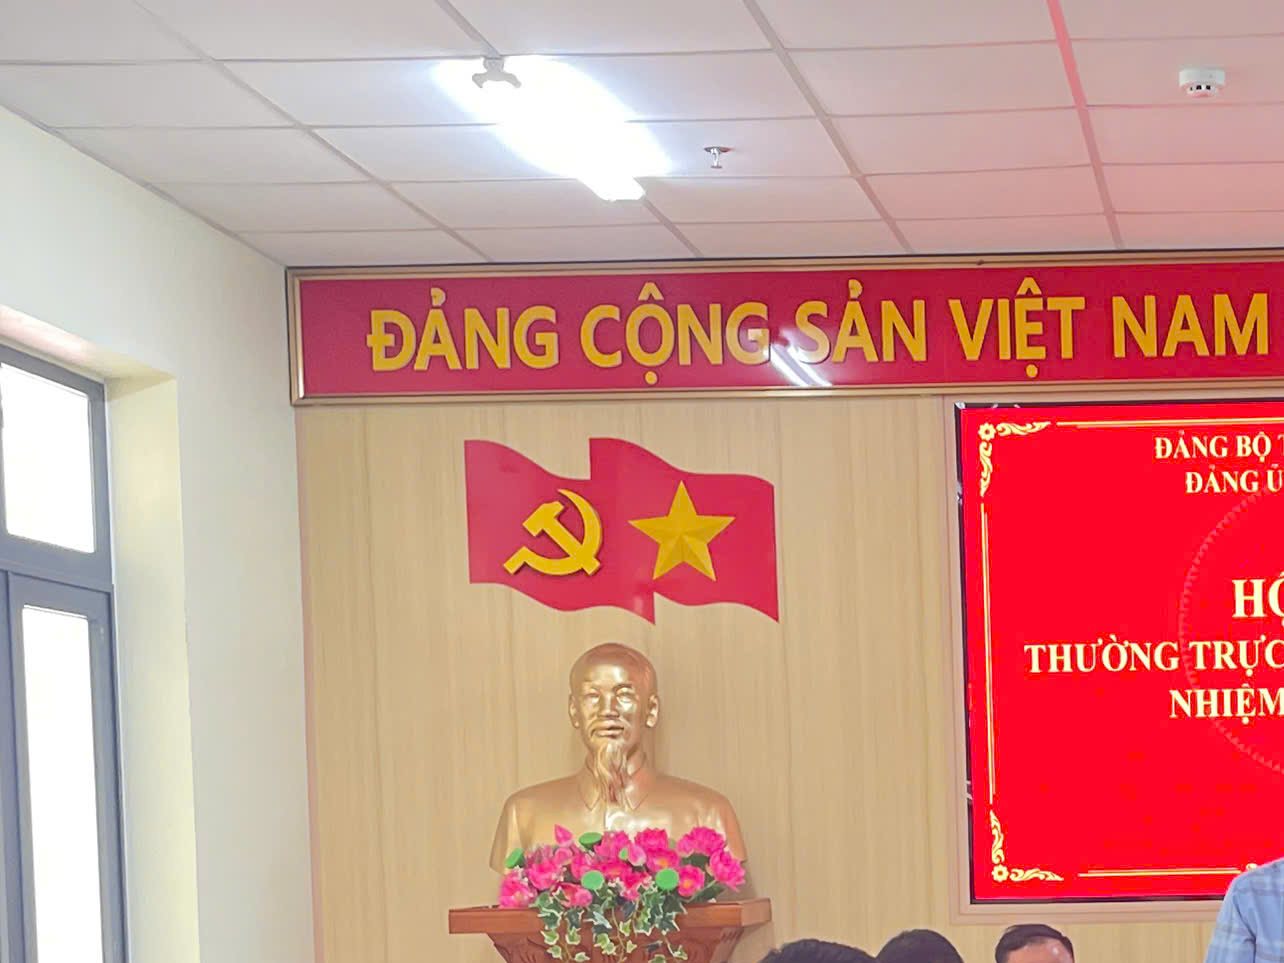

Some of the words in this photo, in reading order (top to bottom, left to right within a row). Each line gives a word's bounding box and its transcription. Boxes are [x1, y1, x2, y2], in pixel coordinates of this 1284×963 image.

[366, 287, 559, 371] ĐẢNG
[580, 282, 770, 384] CỘNG
[796, 279, 927, 366] SẢN
[947, 277, 1085, 379] VIỆT
[1112, 292, 1269, 360] NAM
[1154, 429, 1229, 459] ĐẢNG
[1236, 431, 1272, 462] BỘ
[1185, 464, 1259, 493] ĐẢNG
[1023, 635, 1179, 673] THƯỜNG
